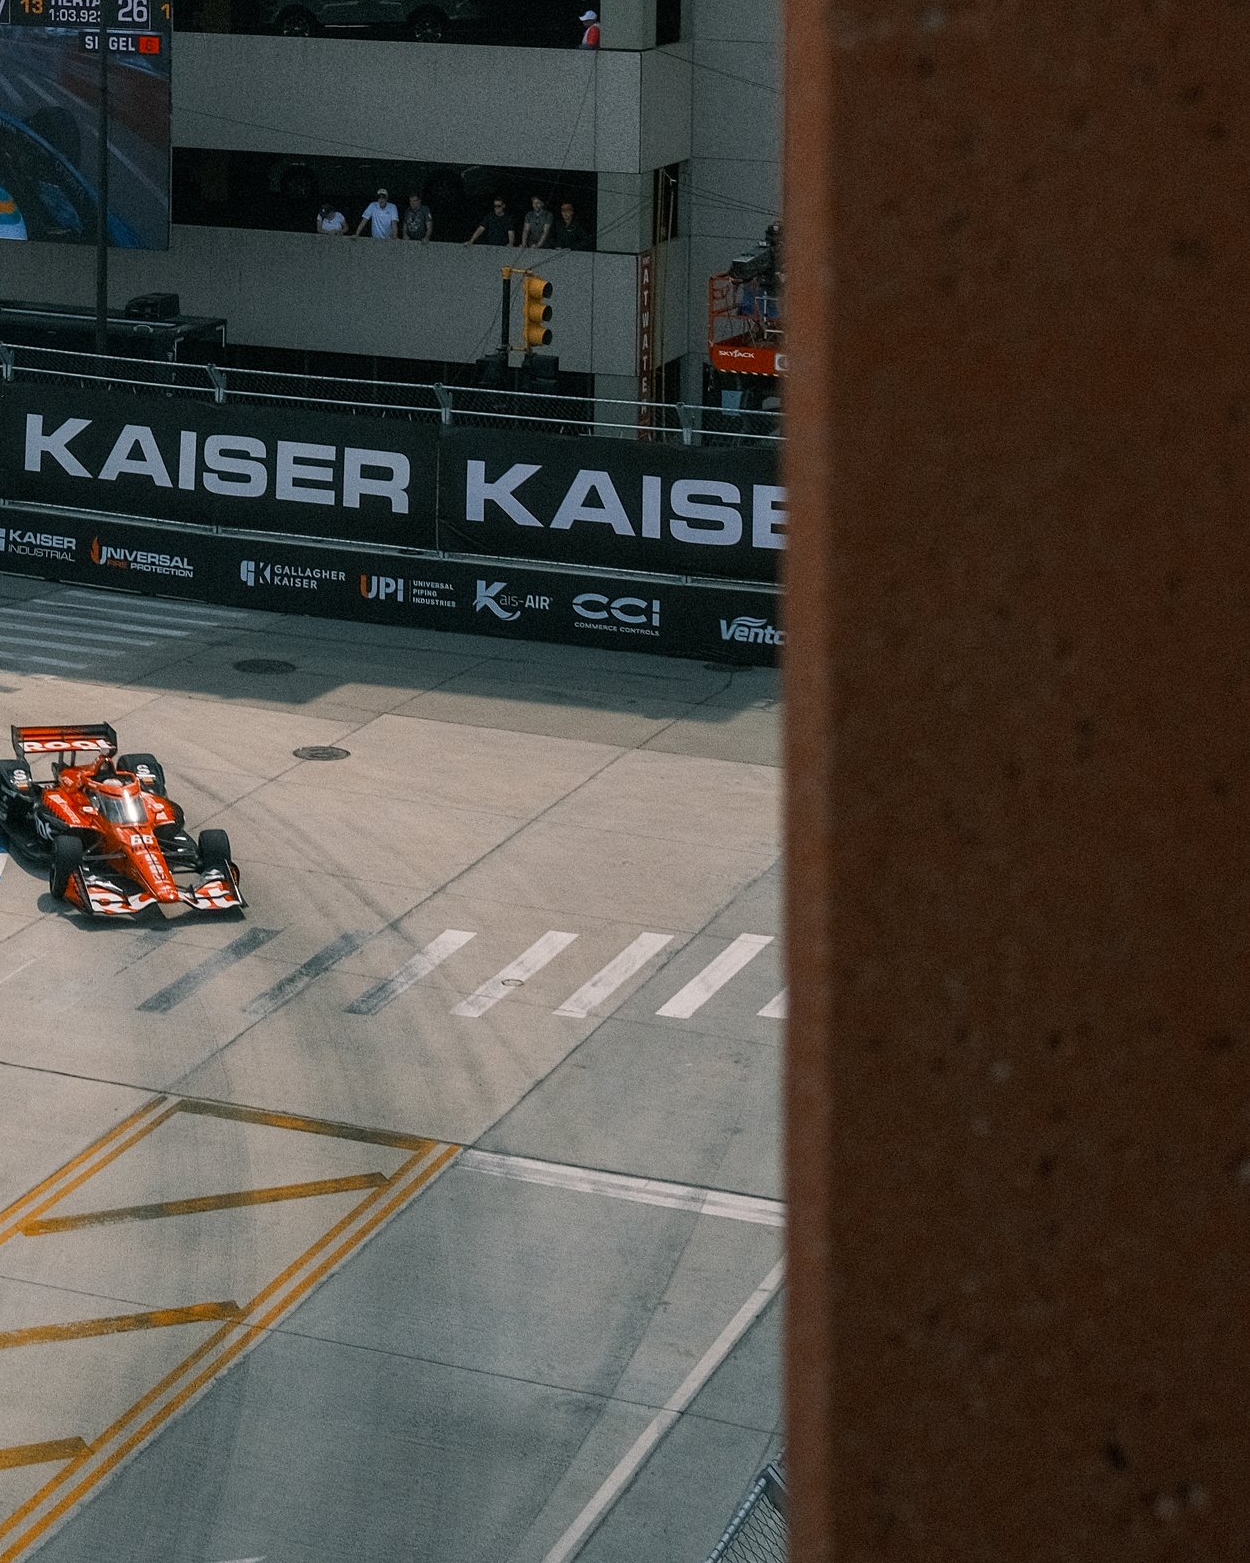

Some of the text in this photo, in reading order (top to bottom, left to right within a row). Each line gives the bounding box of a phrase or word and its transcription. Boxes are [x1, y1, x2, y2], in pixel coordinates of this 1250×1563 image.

[85, 36, 136, 51] SIGEL
[24, 413, 411, 514] KAISER
[466, 460, 787, 550] KAISE
[9, 529, 76, 550] KAISER
[8, 543, 75, 562] INDUSTRIAL
[107, 559, 193, 577] FIRE PROTECTION
[274, 565, 346, 581] GALLAGHER
[274, 576, 317, 589] KAISER
[360, 574, 403, 602] UPI
[413, 580, 454, 590] UNIVERSAL
[413, 589, 437, 597] PIPING
[413, 597, 456, 607] INDUSTRIES
[572, 593, 660, 626] CCI
[575, 622, 660, 636] COMMERCE CONTROLS
[719, 616, 786, 645] Ventc
